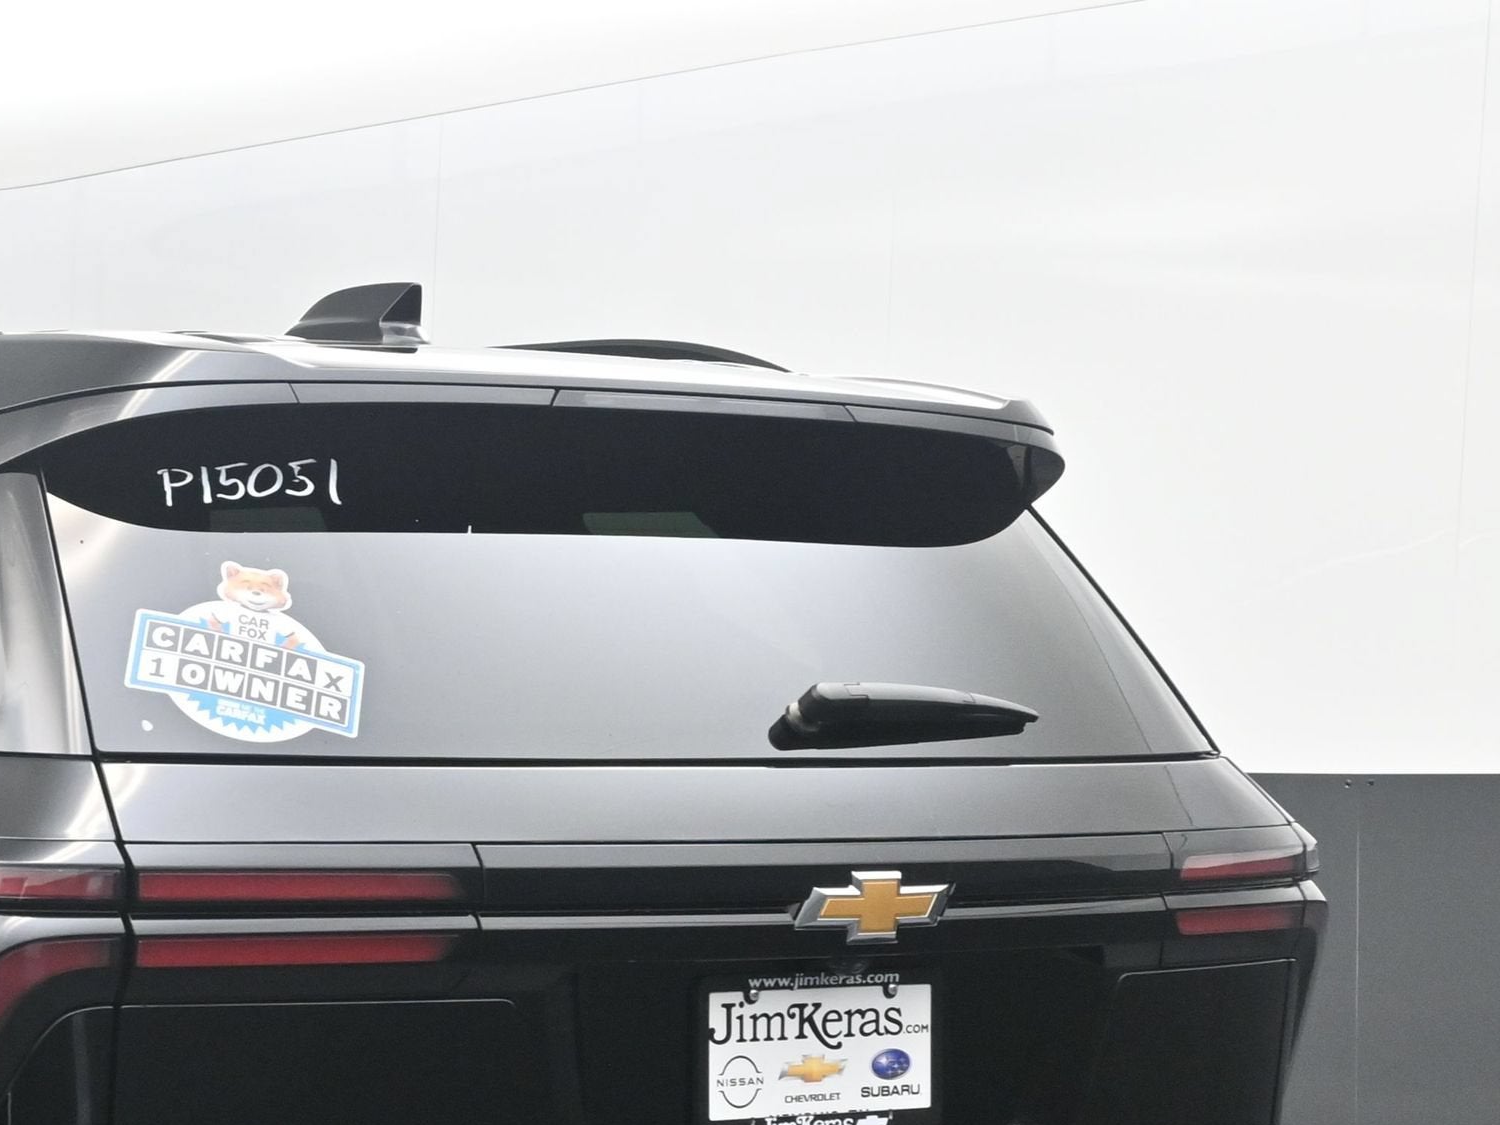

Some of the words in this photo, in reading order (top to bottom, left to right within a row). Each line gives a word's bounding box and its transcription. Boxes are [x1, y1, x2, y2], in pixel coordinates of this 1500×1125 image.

[156, 458, 342, 507] P15051
[238, 613, 270, 630] CAR
[238, 625, 268, 641] FOX
[151, 625, 345, 693] CARFAX
[148, 657, 165, 678] 1
[180, 668, 343, 722] OWNER
[748, 972, 900, 990] www.jimkeras.com
[716, 1076, 765, 1088] NISSAN
[784, 1092, 842, 1104] CHEVROLET
[860, 1084, 921, 1098] SUBARU
